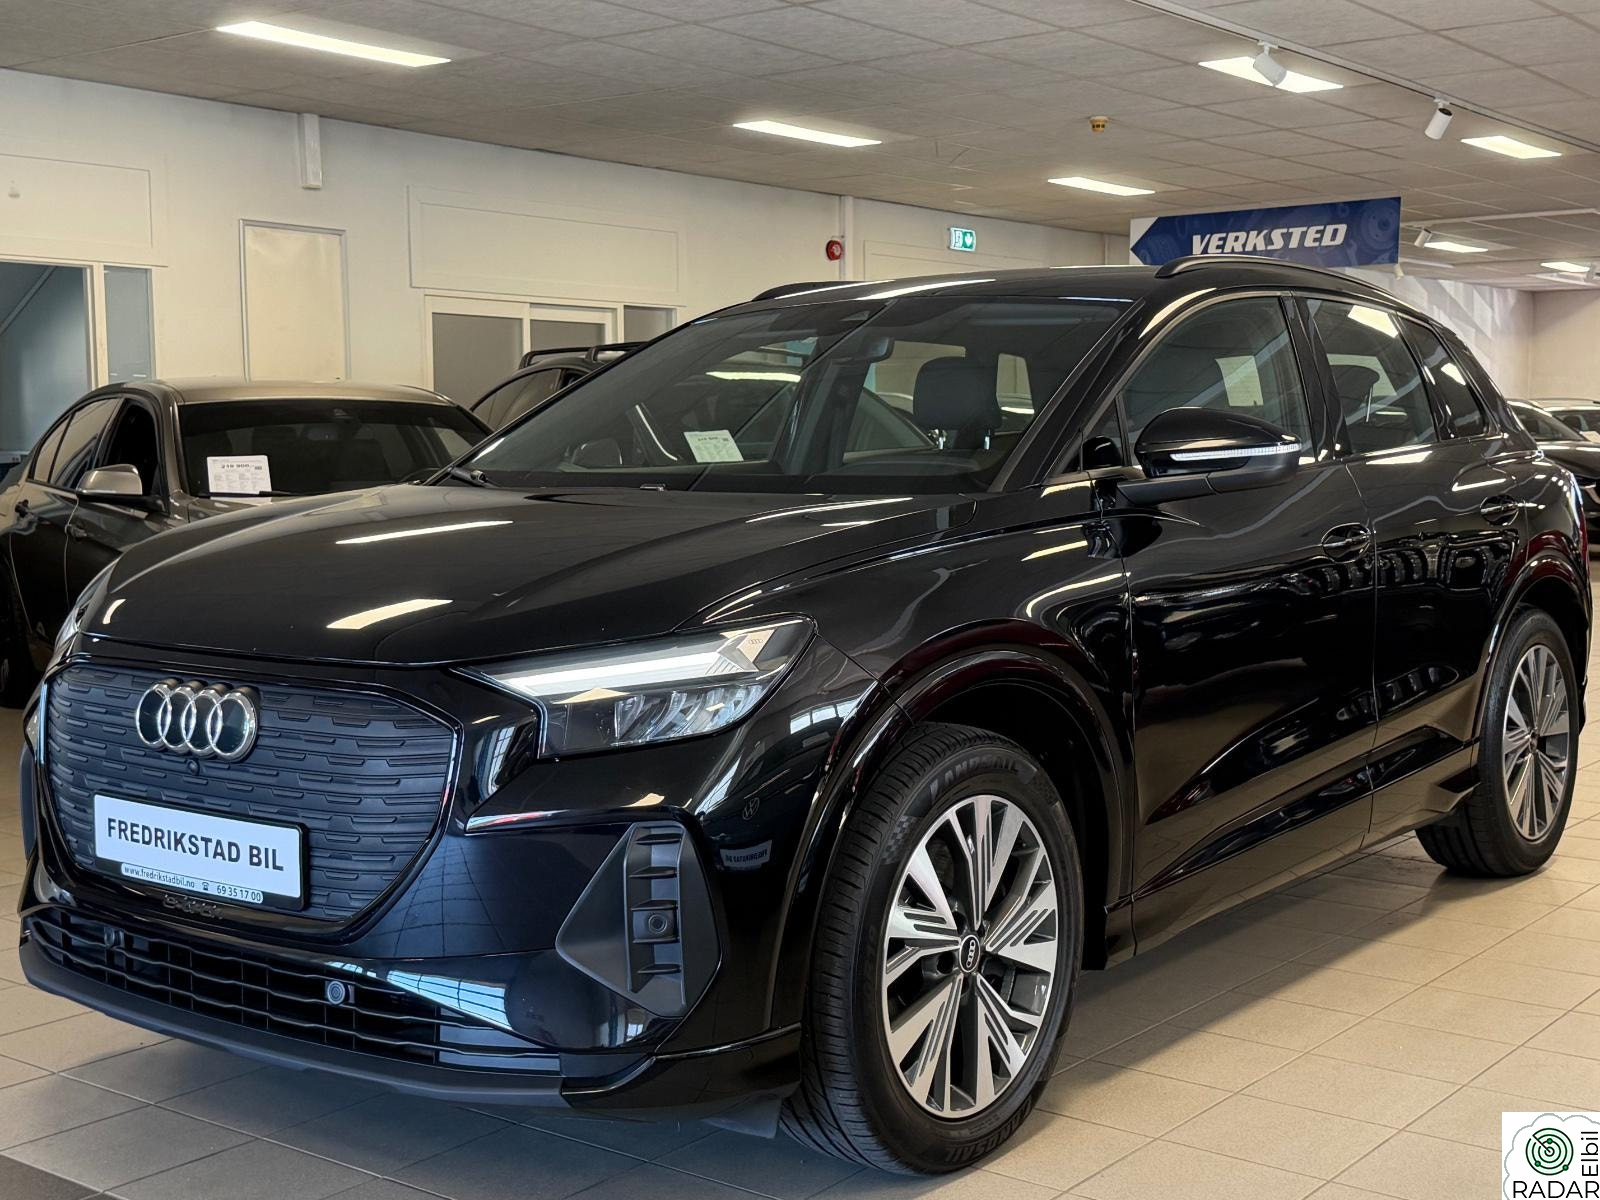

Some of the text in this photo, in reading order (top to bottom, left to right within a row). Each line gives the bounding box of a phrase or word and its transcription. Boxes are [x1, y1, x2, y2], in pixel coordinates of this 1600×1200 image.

[1192, 223, 1348, 255] VERKSTED
[107, 817, 284, 872] FREDRIKSTAD BIL
[124, 865, 261, 902] www.fredrikstadbil.no 69 35 17 00
